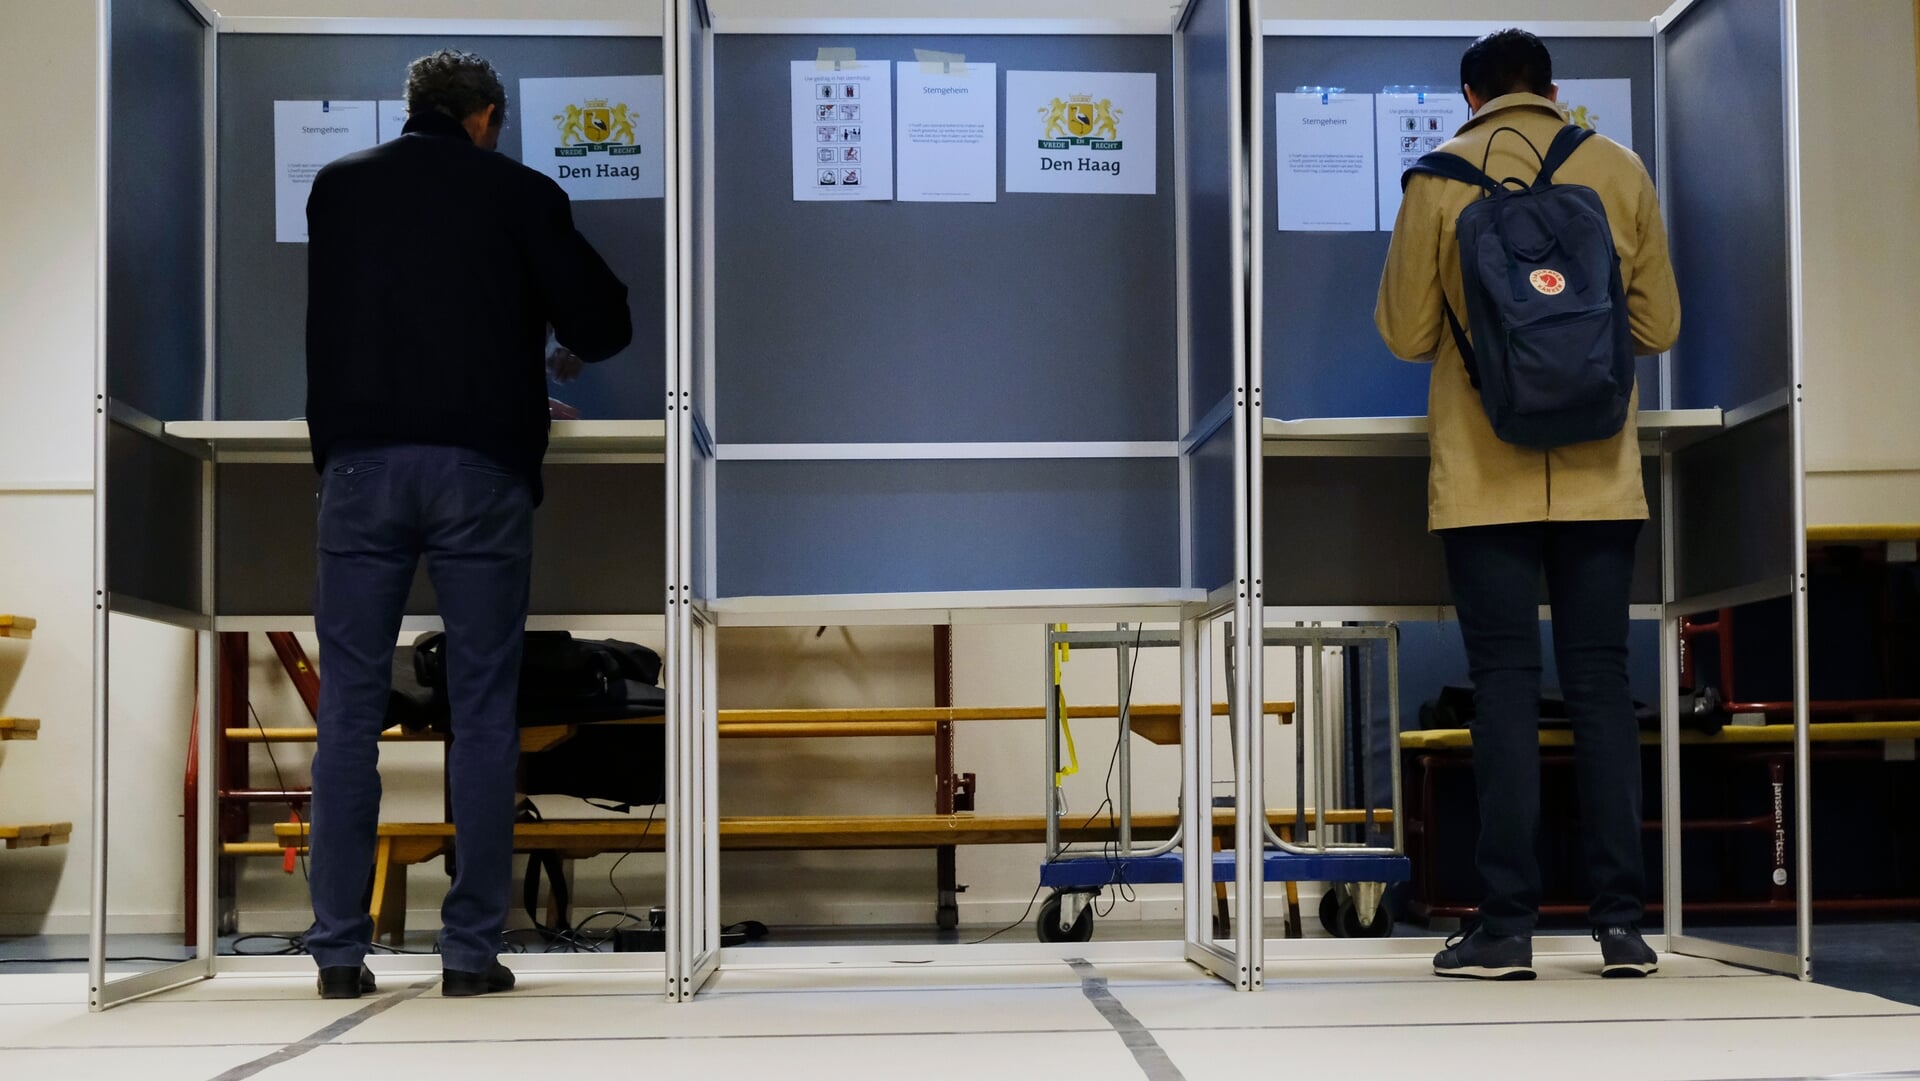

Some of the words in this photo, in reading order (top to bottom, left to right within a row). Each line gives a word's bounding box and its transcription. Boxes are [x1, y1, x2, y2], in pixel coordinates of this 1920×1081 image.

[923, 86, 968, 95] Stemgeheim
[1302, 117, 1347, 126] Stemgeheim
[302, 126, 349, 135] Stemgeheim
[1040, 157, 1072, 171] Den
[1078, 158, 1120, 176] Haag
[558, 165, 591, 179] Den
[596, 164, 640, 181] Haag
